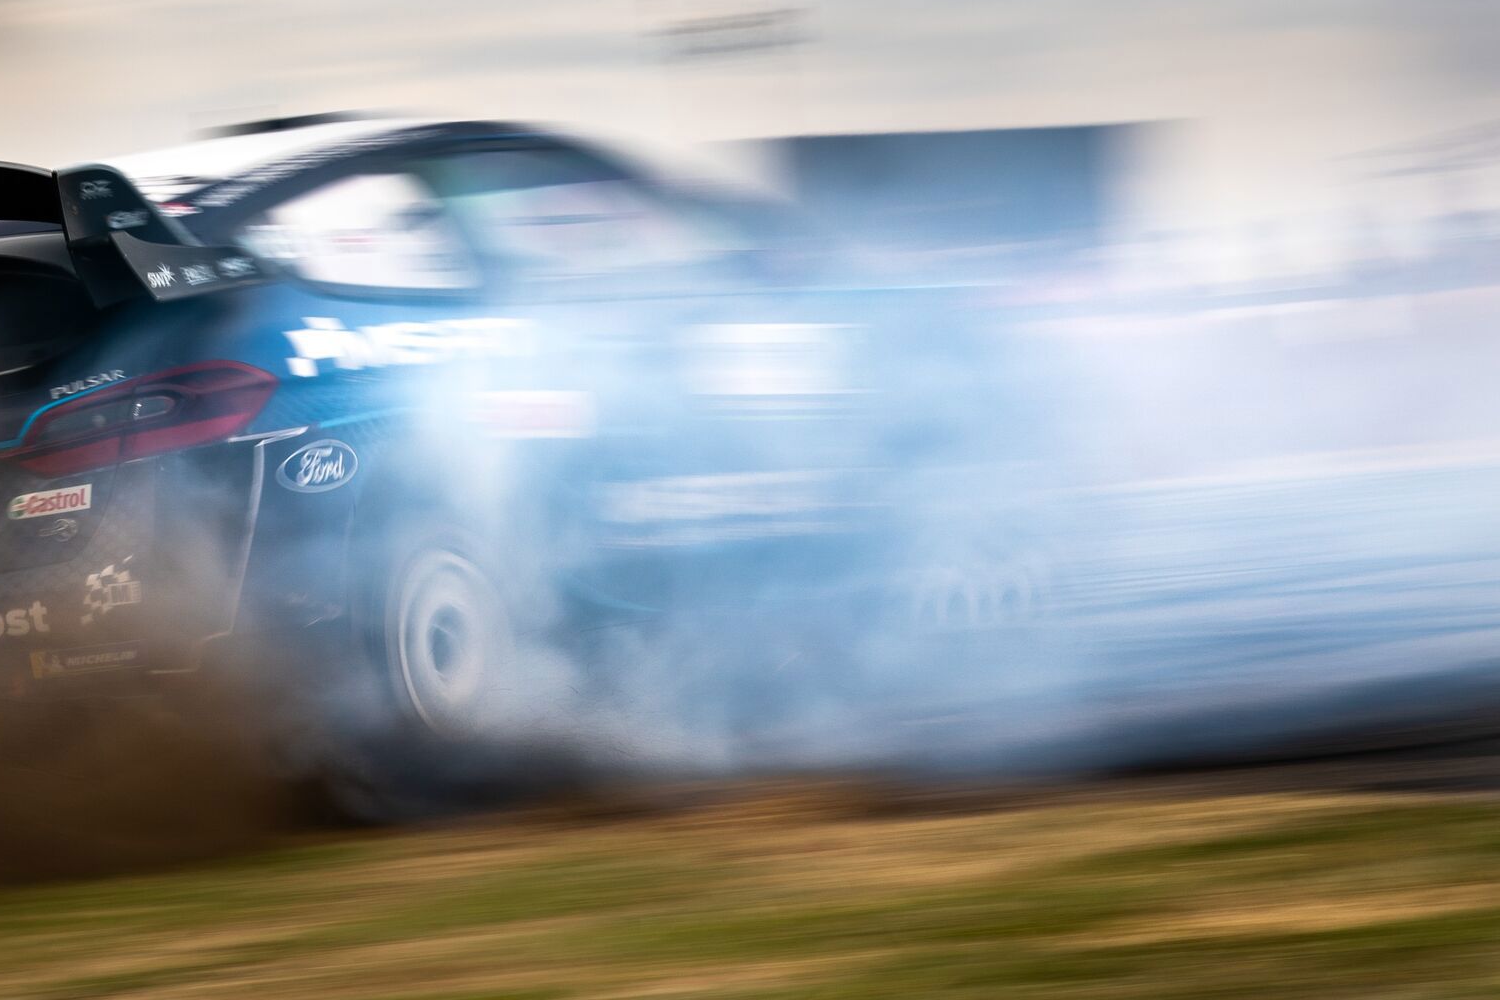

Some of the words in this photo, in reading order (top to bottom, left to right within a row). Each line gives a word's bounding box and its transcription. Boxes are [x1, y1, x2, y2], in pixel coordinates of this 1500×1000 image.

[50, 369, 126, 400] PULSAR
[296, 446, 346, 487] Ford
[24, 487, 88, 515] Castrol
